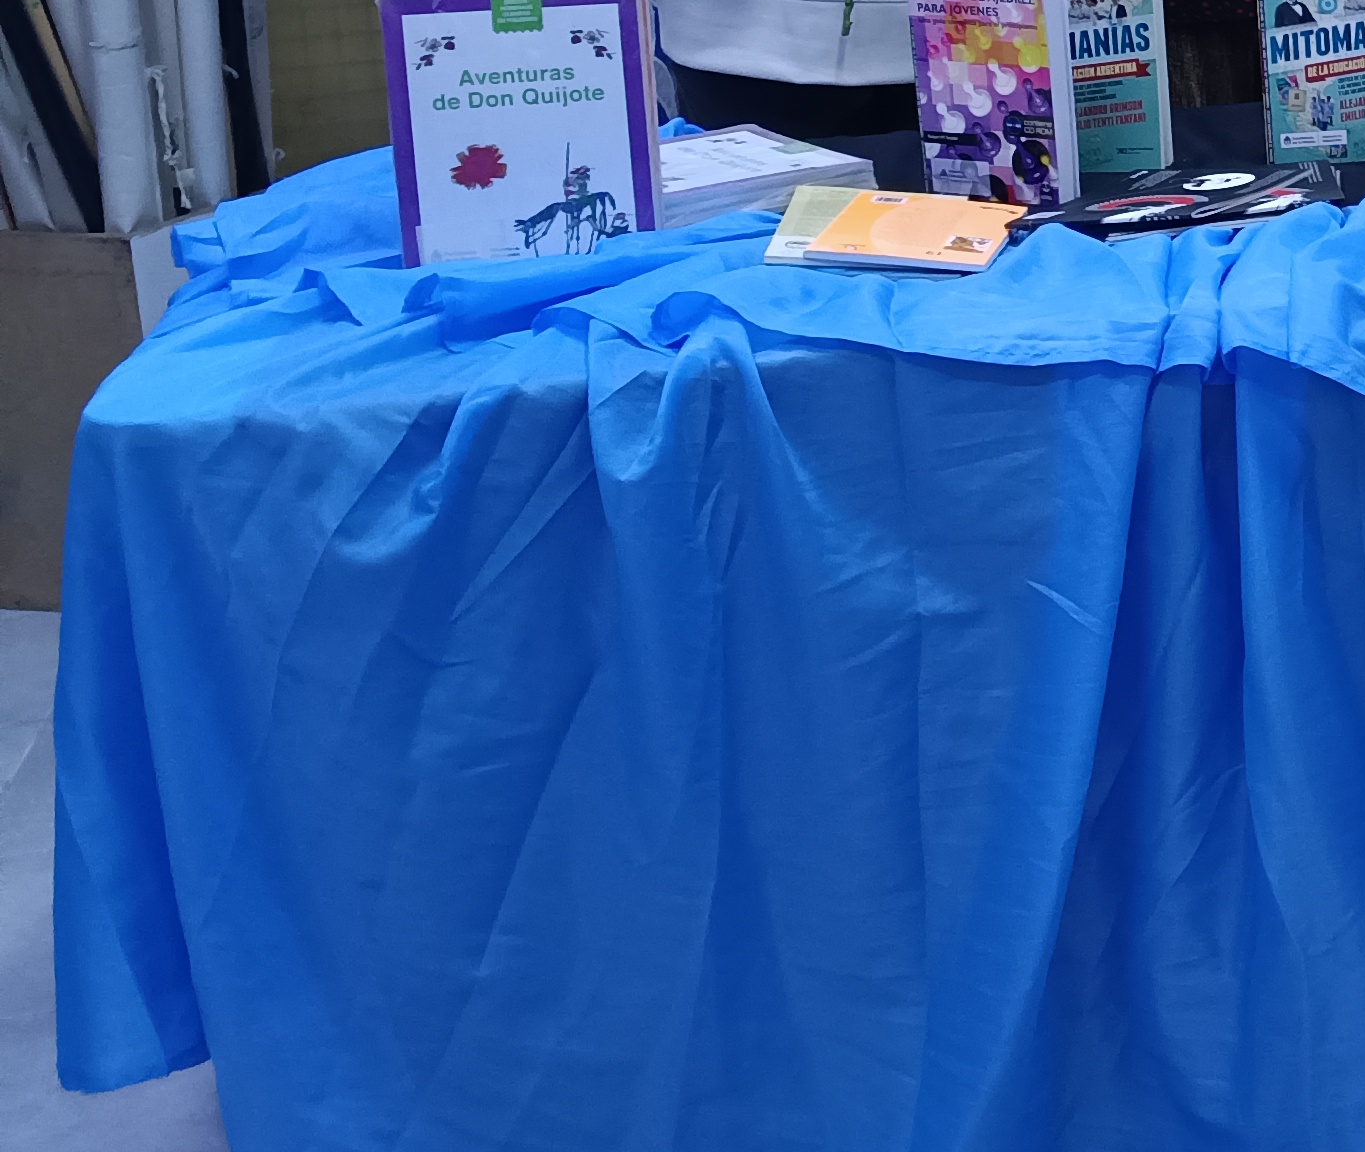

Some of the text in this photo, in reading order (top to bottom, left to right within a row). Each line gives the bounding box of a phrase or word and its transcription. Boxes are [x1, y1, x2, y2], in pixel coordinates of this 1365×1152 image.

[917, 1, 999, 18] PARA JÓVENES
[1069, 22, 1150, 61] ANÍAS
[459, 66, 575, 87] Aventuras
[1308, 66, 1318, 78] DE
[1319, 64, 1329, 76] LA
[432, 86, 605, 111] de Don Quijote
